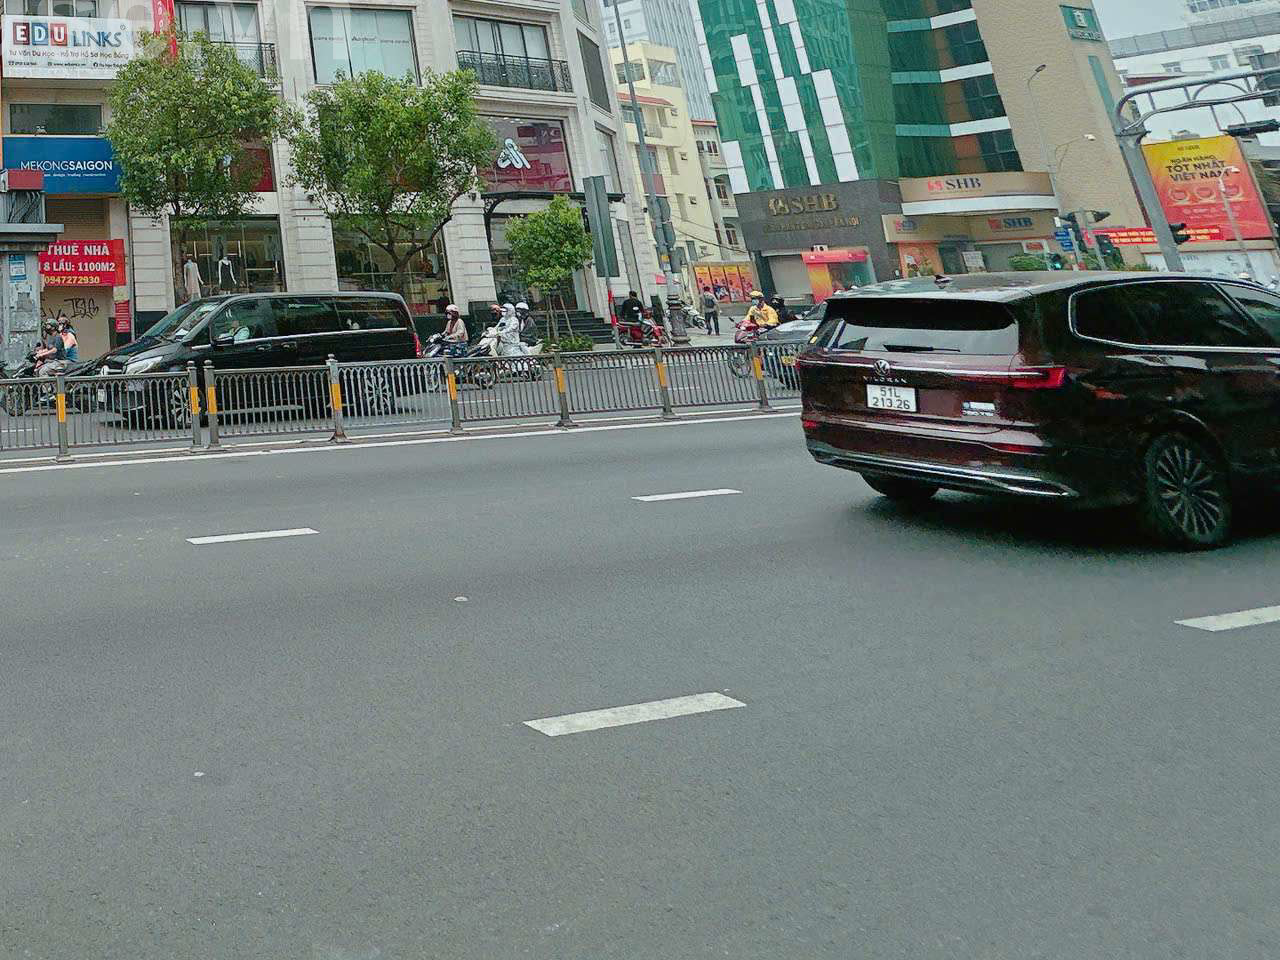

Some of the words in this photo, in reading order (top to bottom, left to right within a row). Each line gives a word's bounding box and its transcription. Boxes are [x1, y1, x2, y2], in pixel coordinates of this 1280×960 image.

[945, 177, 982, 190] SHB
[43, 262, 51, 272] 8
[77, 262, 116, 272] 1100M2
[880, 386, 901, 398] 51L
[872, 396, 911, 410] 213.26
